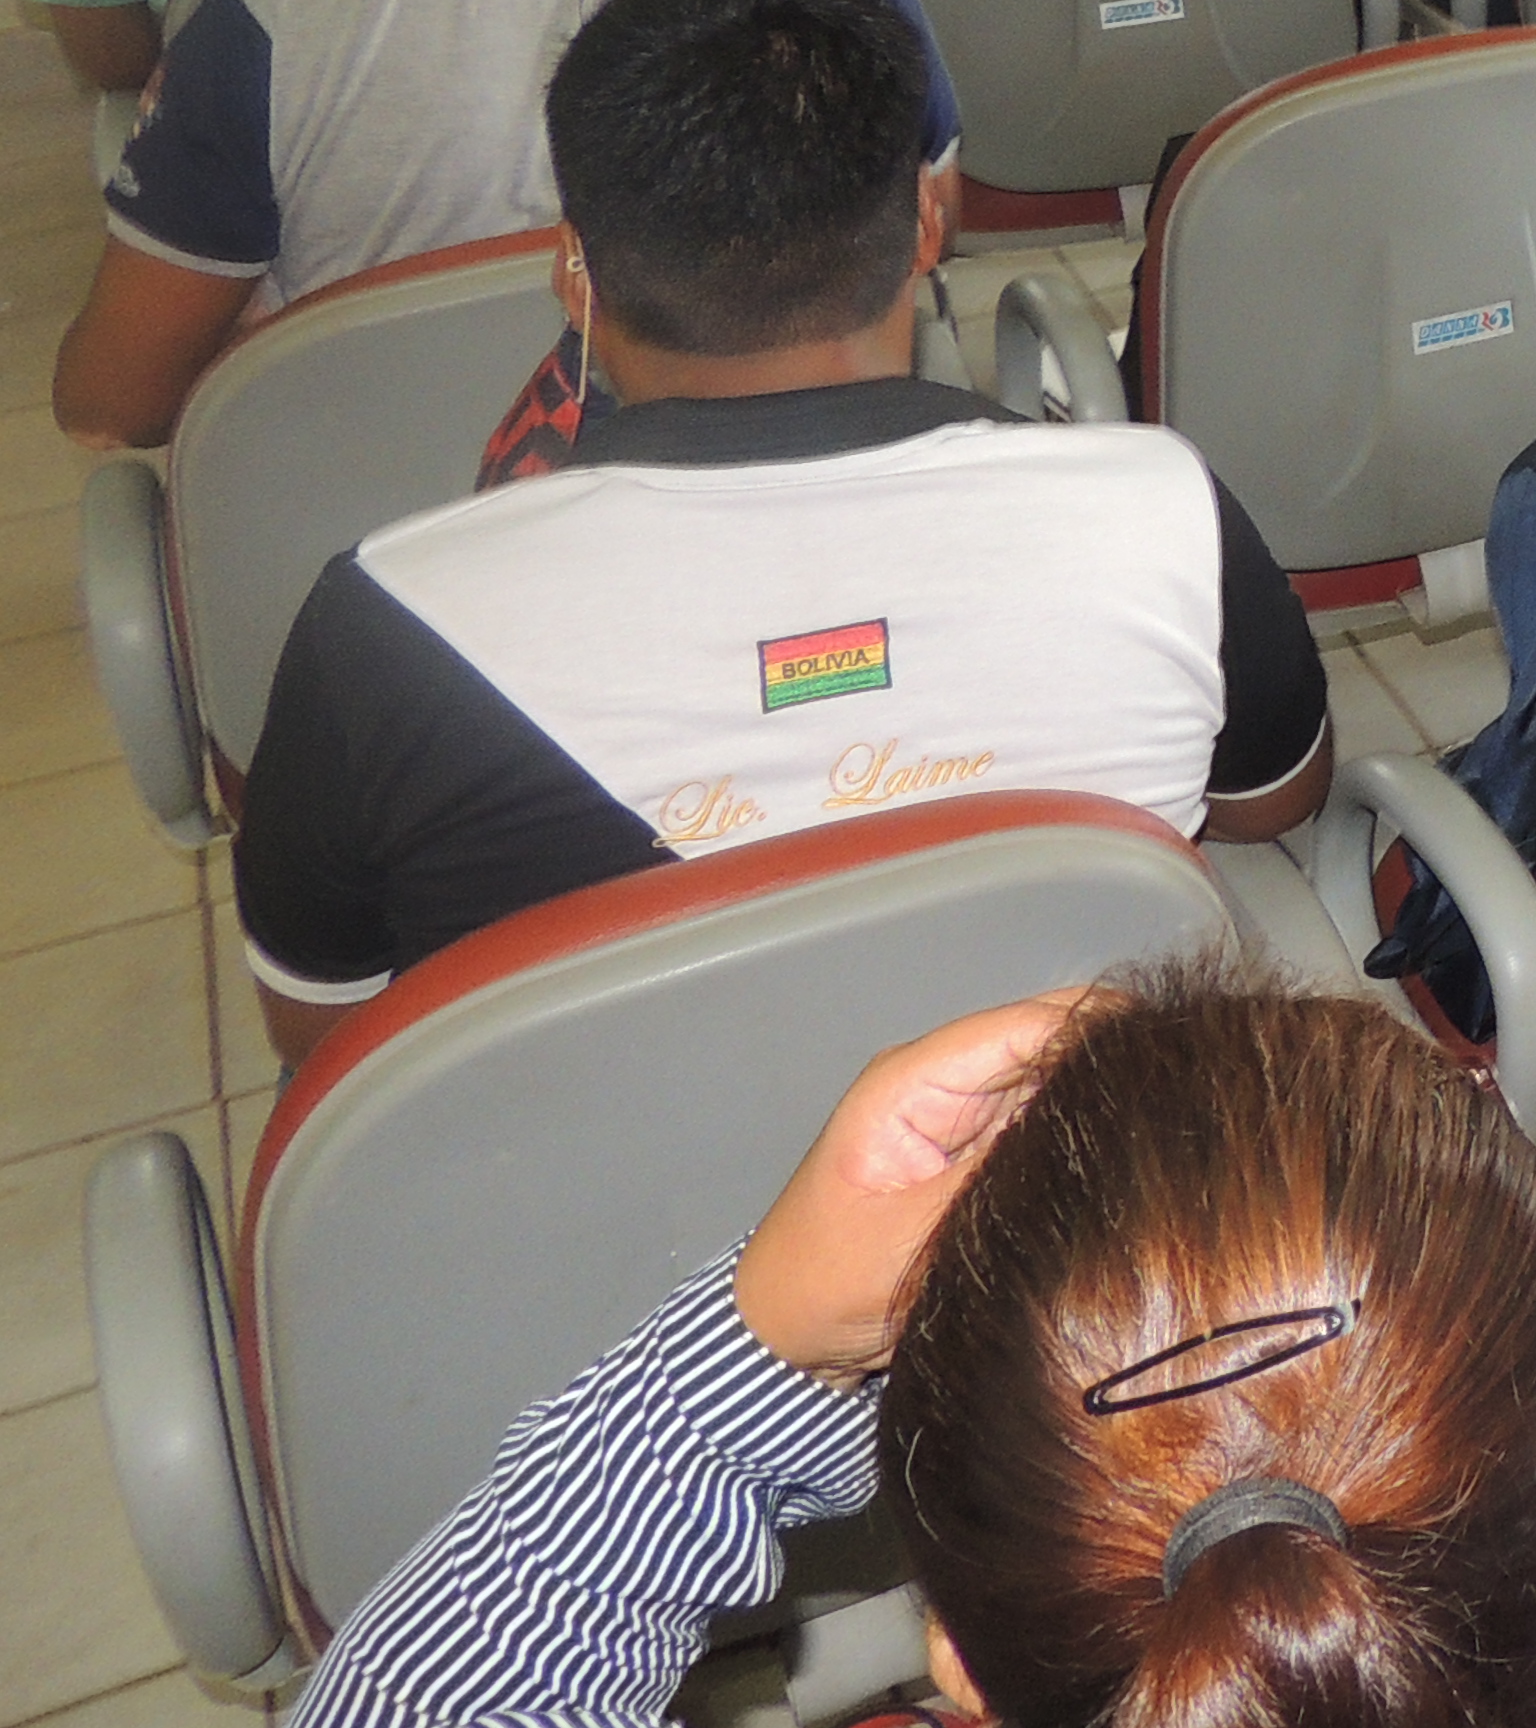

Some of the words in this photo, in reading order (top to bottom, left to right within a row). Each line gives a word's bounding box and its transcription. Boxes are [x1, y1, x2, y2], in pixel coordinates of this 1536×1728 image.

[780, 646, 872, 681] BOLIVIA
[652, 775, 767, 849] Lic.
[821, 737, 996, 809] Laime
